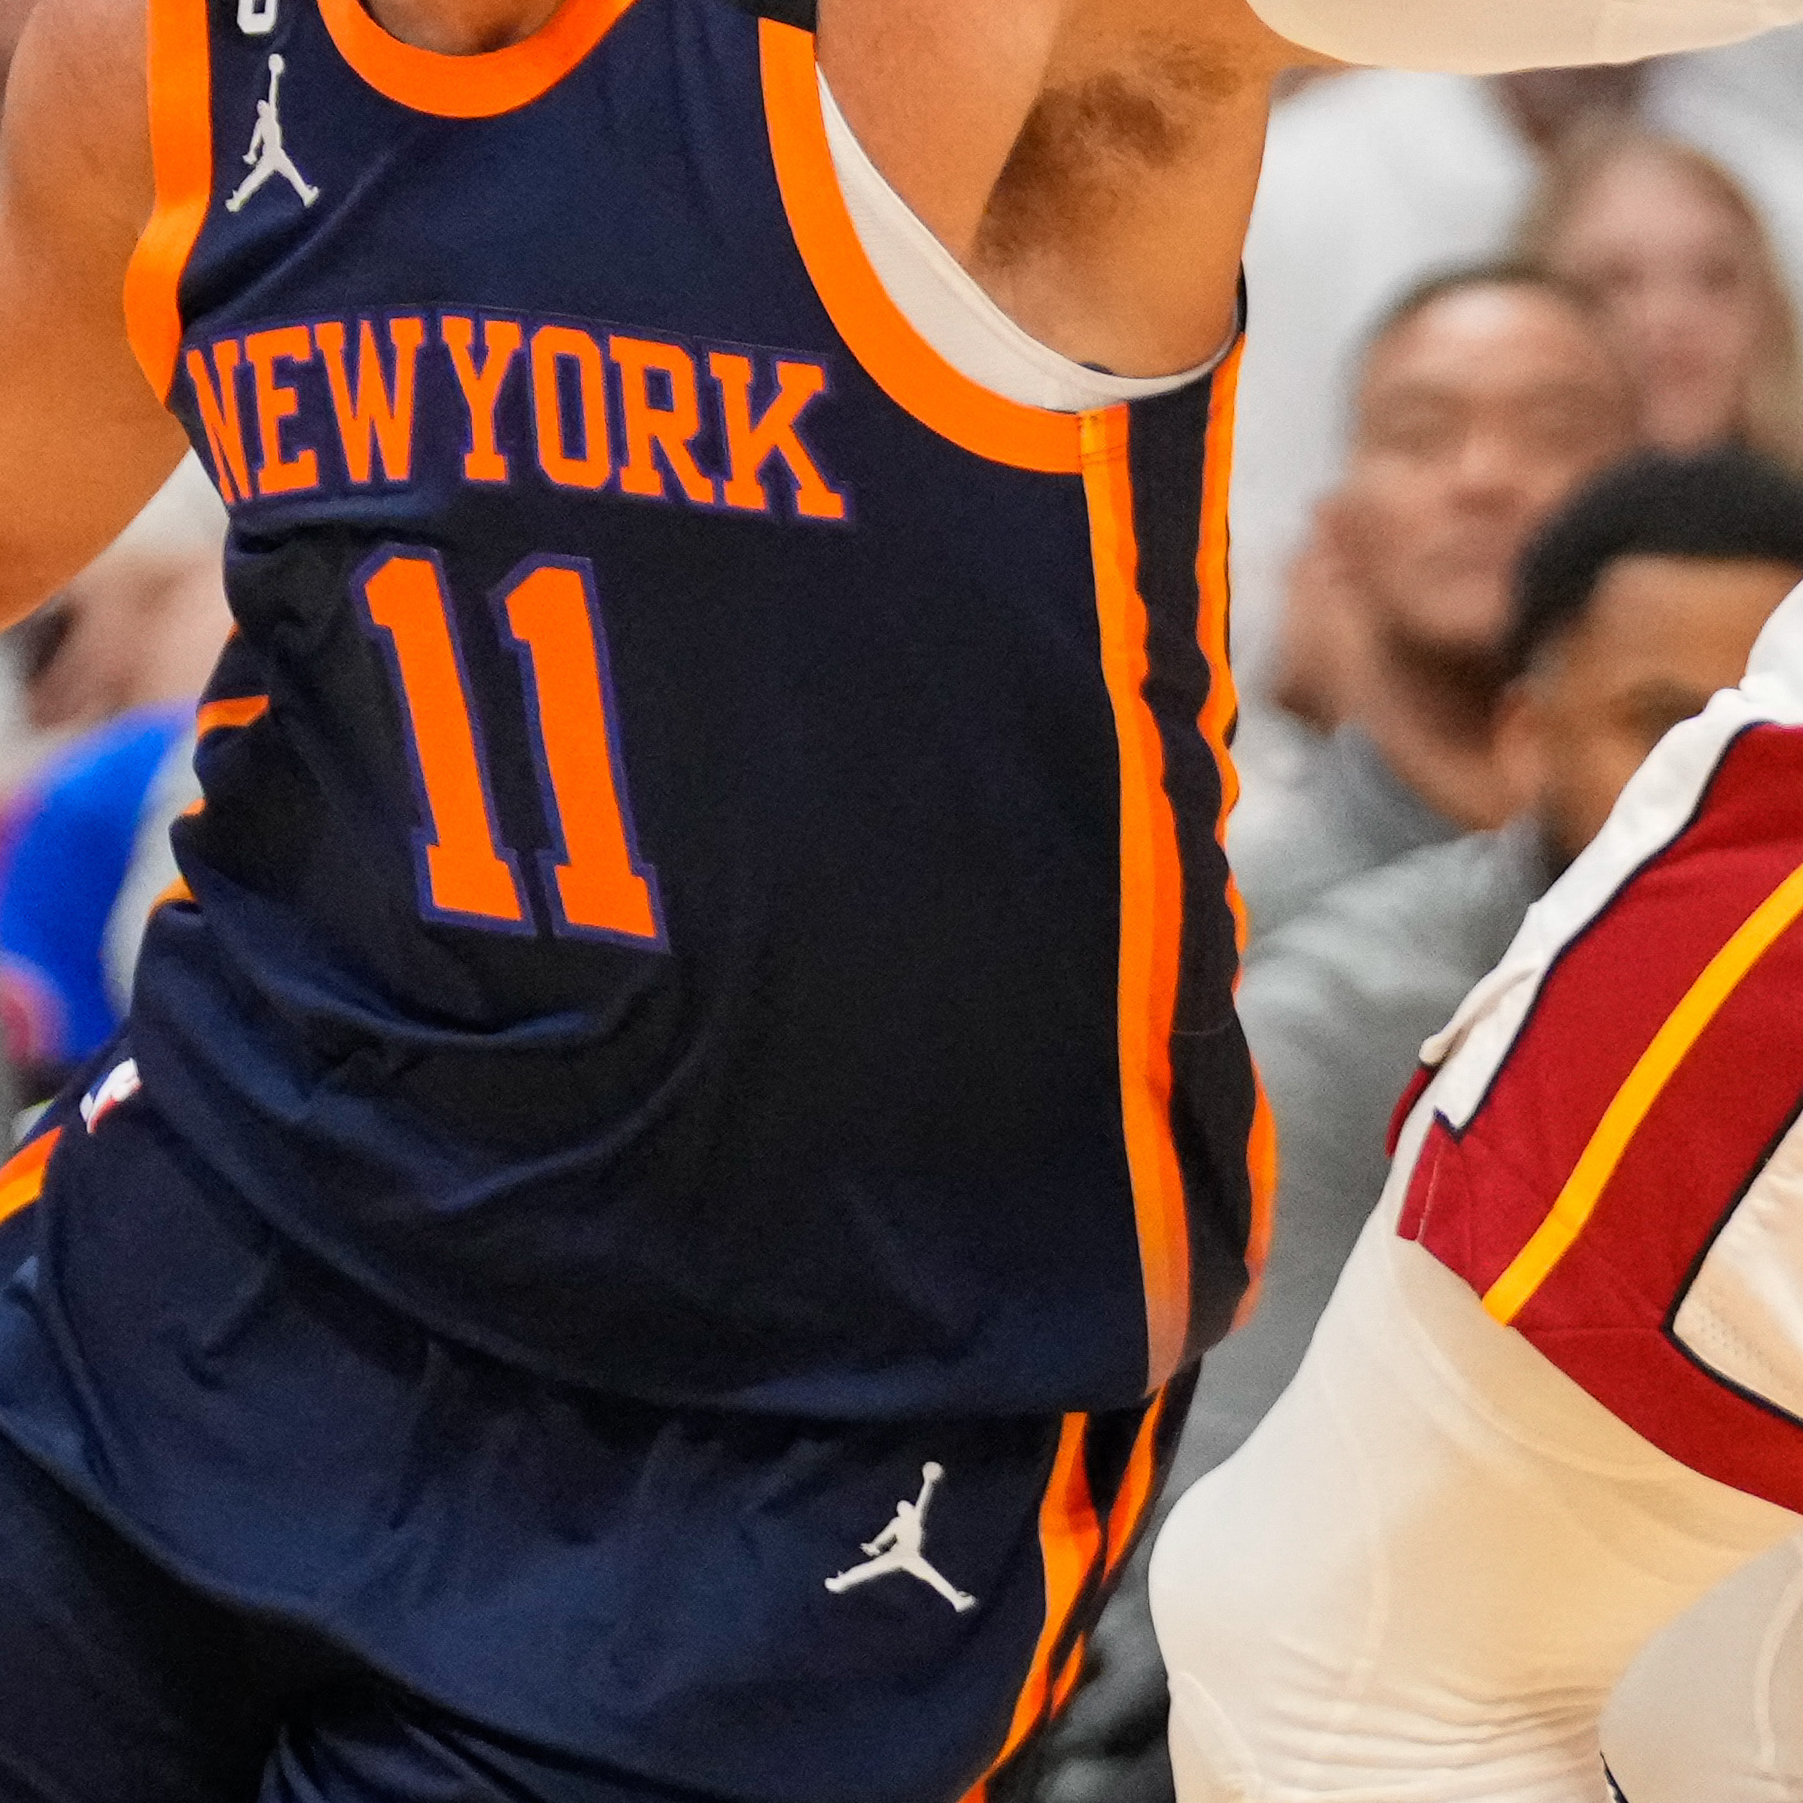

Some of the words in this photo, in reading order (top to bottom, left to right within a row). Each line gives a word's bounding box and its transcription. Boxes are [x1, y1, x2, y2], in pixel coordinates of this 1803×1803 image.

[184, 310, 426, 506] NEW
[438, 311, 850, 521] YORK
[350, 542, 672, 955] 11
